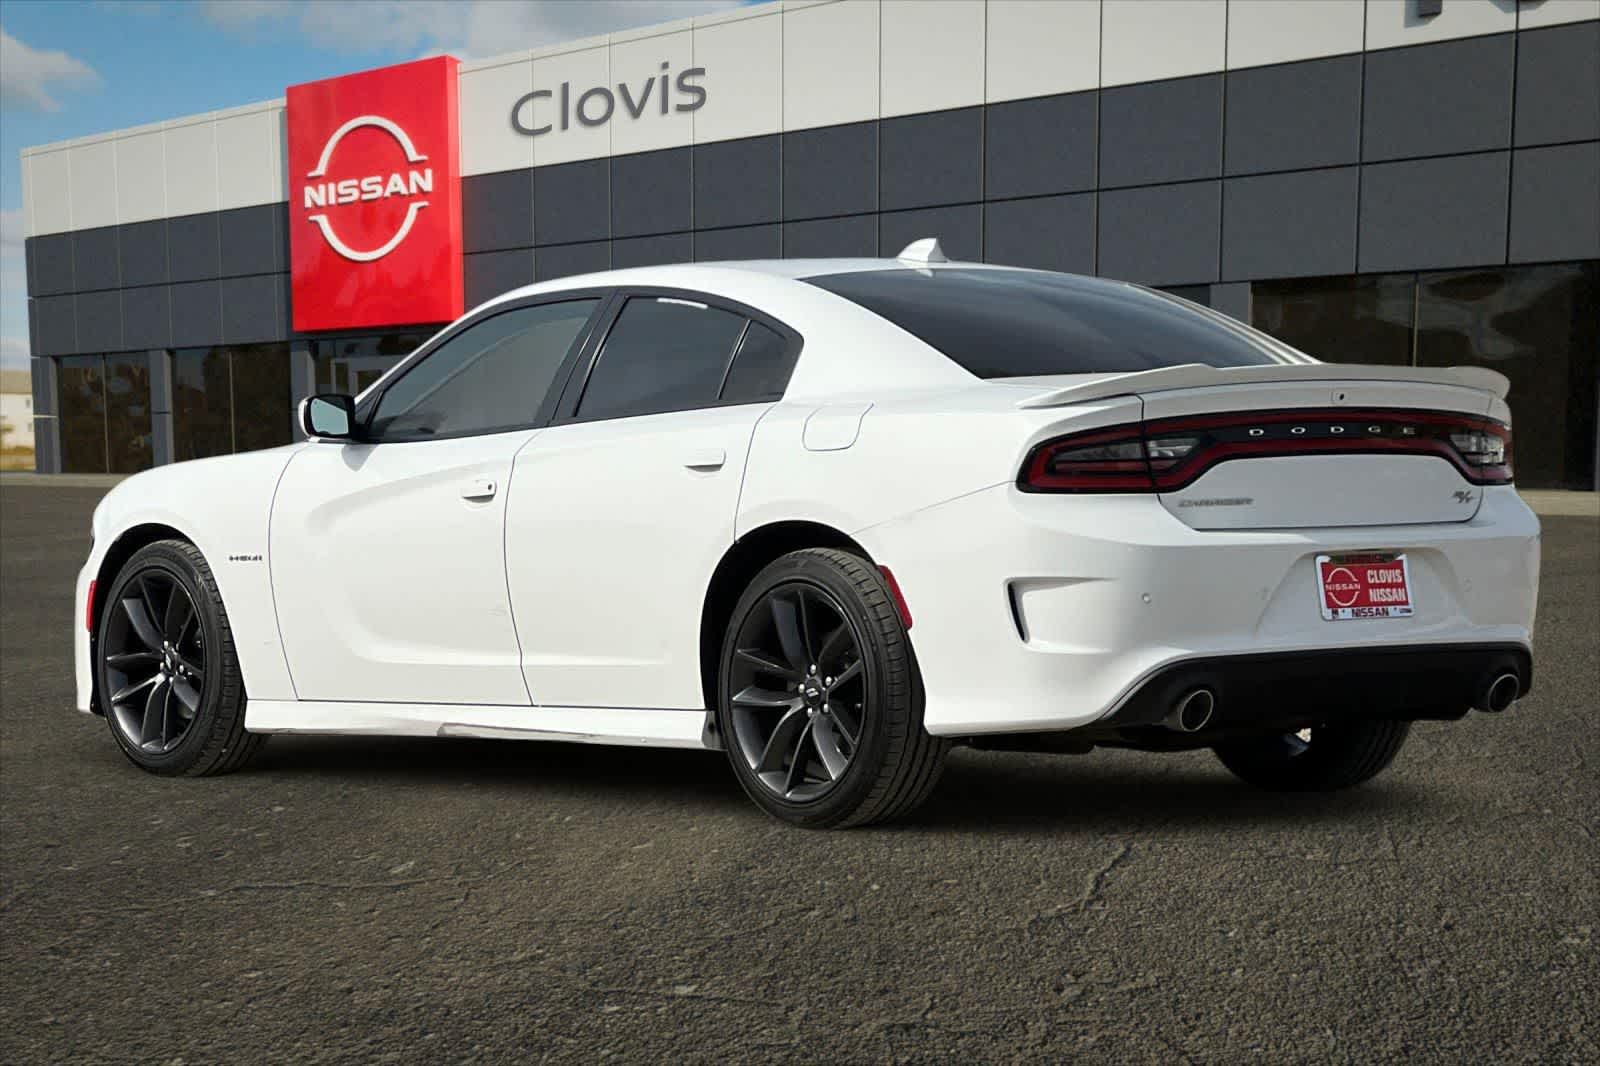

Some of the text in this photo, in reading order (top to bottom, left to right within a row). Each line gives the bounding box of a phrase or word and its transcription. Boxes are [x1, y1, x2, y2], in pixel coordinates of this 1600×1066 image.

[511, 62, 708, 136] Clovis
[304, 168, 433, 208] NISSAN
[1248, 425, 1416, 436] DODGE
[1367, 569, 1403, 584] CLOVIS
[1325, 583, 1361, 591] NISSAN
[1369, 588, 1407, 602] NISSAN
[1351, 607, 1390, 618] NISSAN
